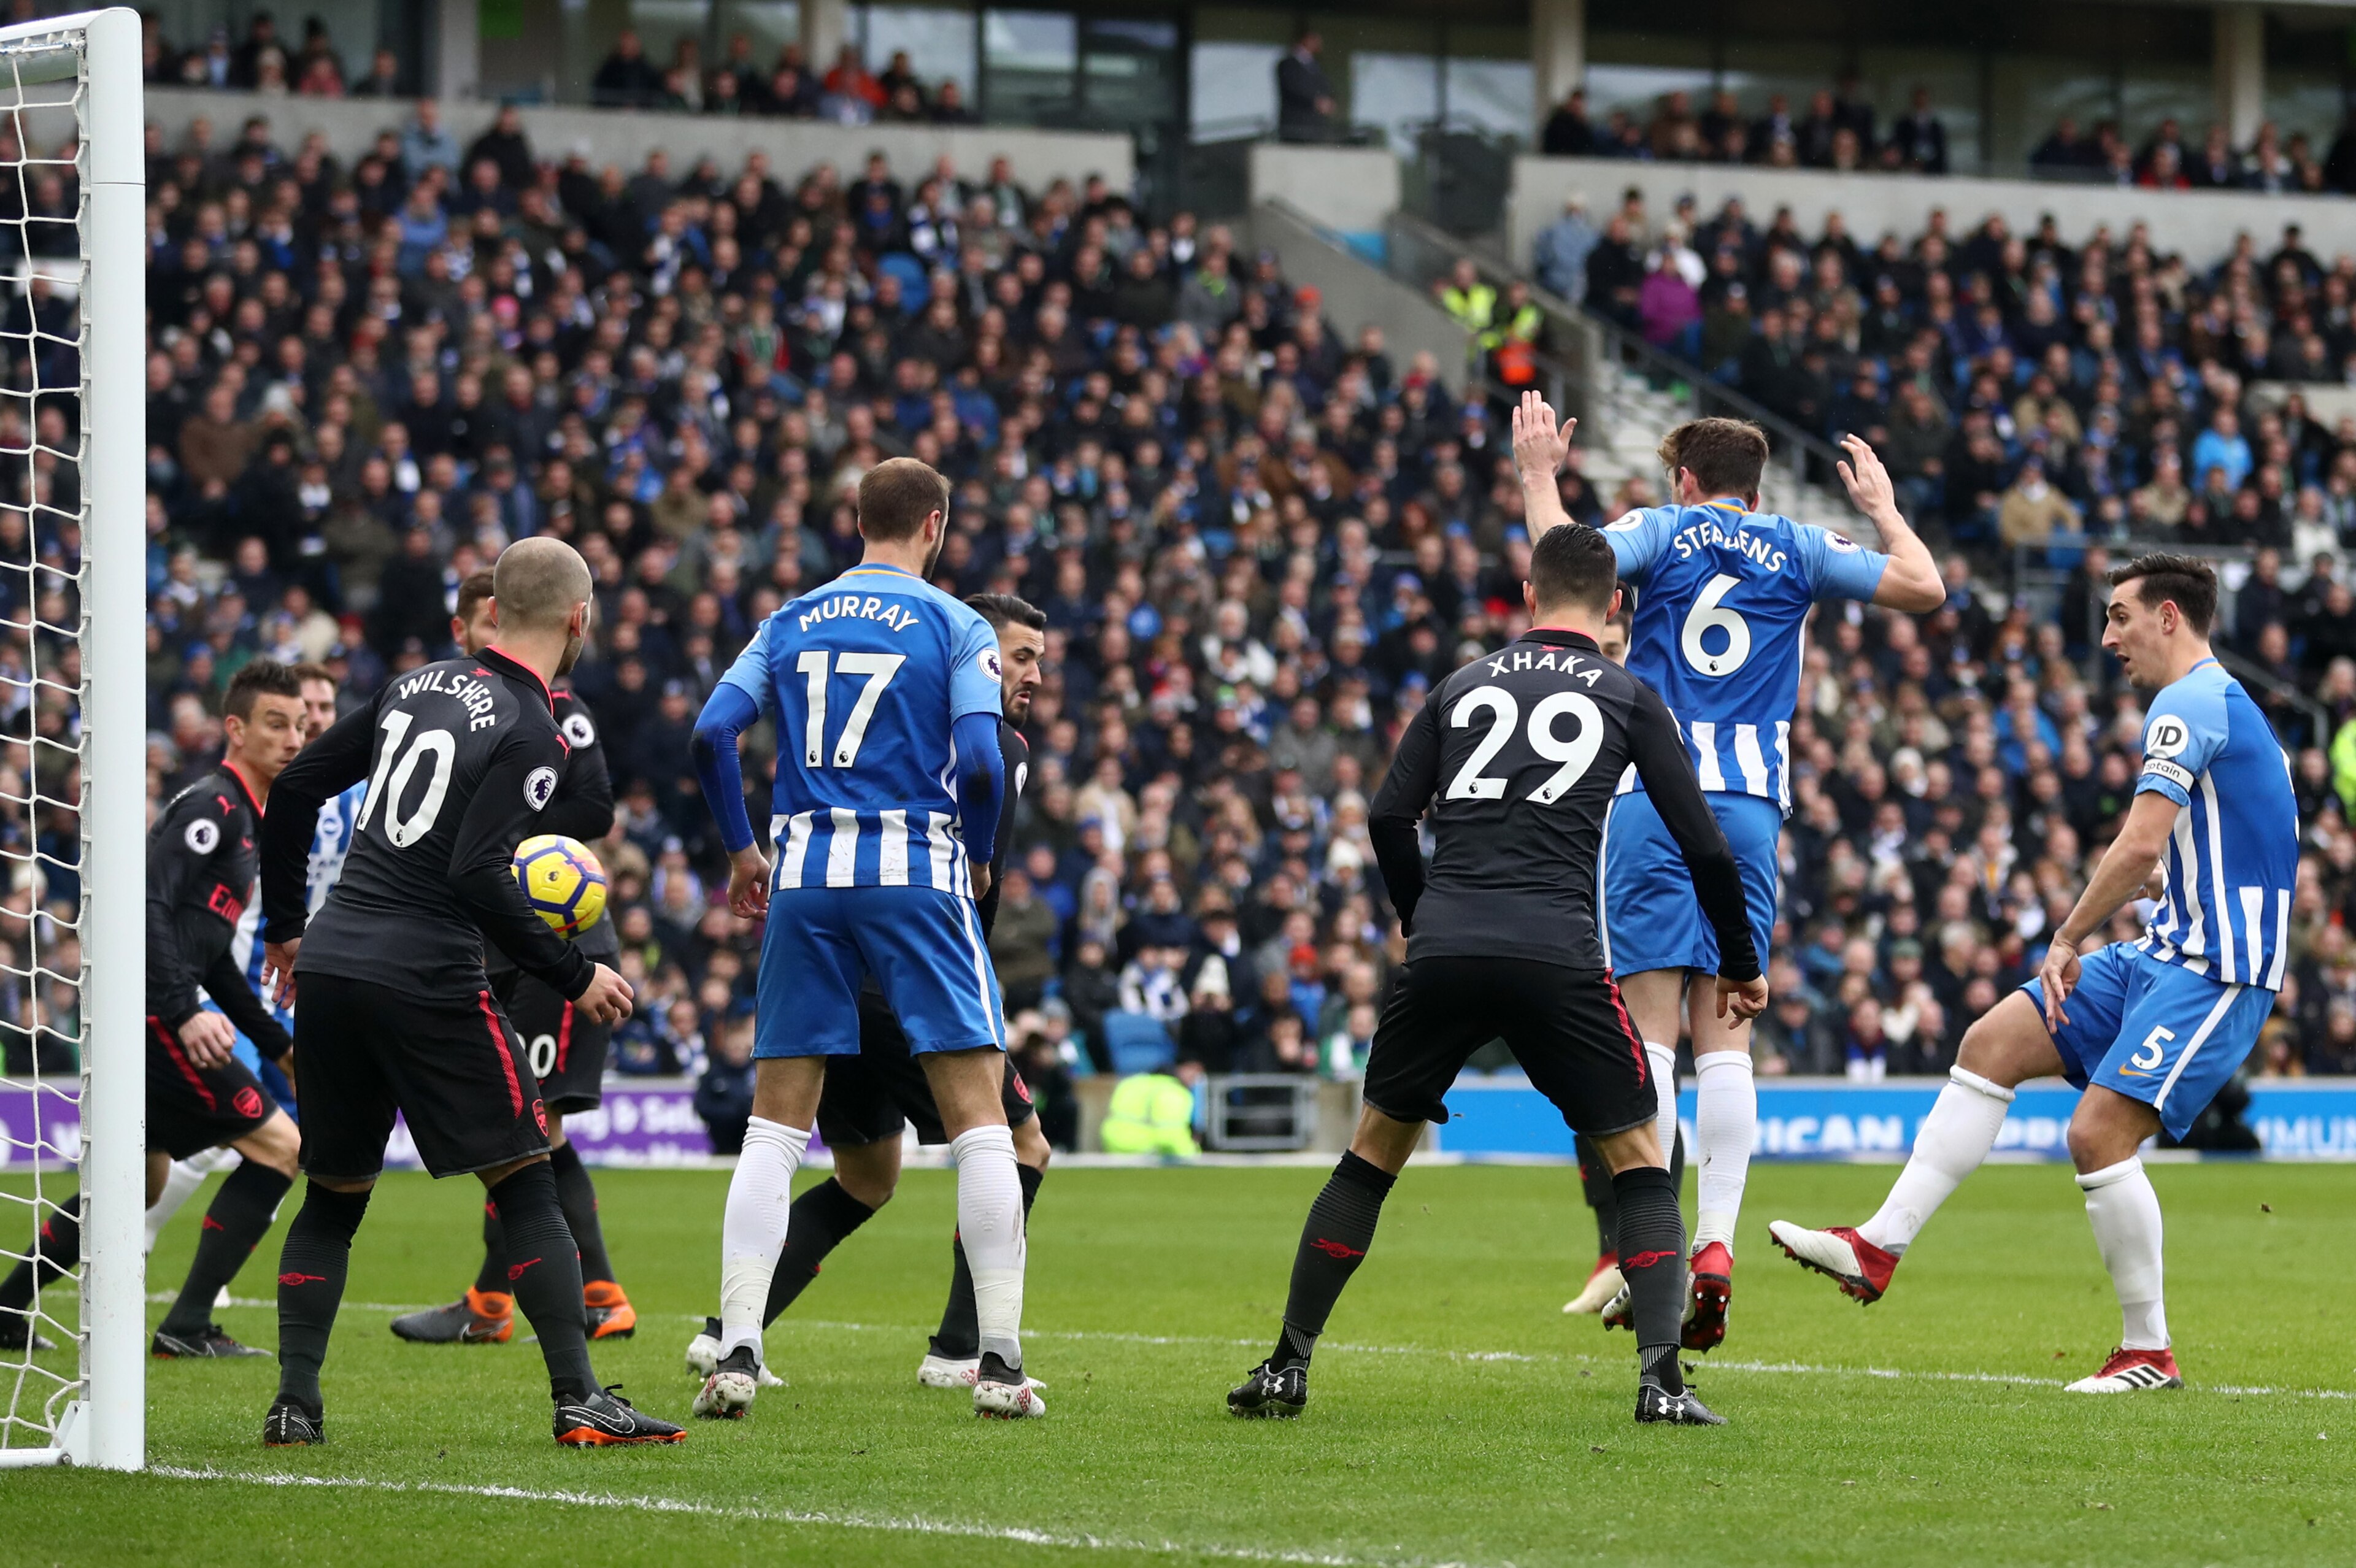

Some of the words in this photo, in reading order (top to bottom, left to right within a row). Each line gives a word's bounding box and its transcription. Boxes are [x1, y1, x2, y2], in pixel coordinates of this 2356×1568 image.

[1673, 521, 1787, 572] STEPHENS
[798, 595, 920, 633] MURRAY
[1681, 573, 1751, 677] 6
[1487, 651, 1603, 688] XHAKA
[399, 670, 496, 732] WILSHERE
[796, 650, 907, 768] 17
[1445, 685, 1604, 805] 29
[2150, 726, 2182, 748] JD
[356, 709, 456, 848] 10
[2131, 1024, 2176, 1070] 5
